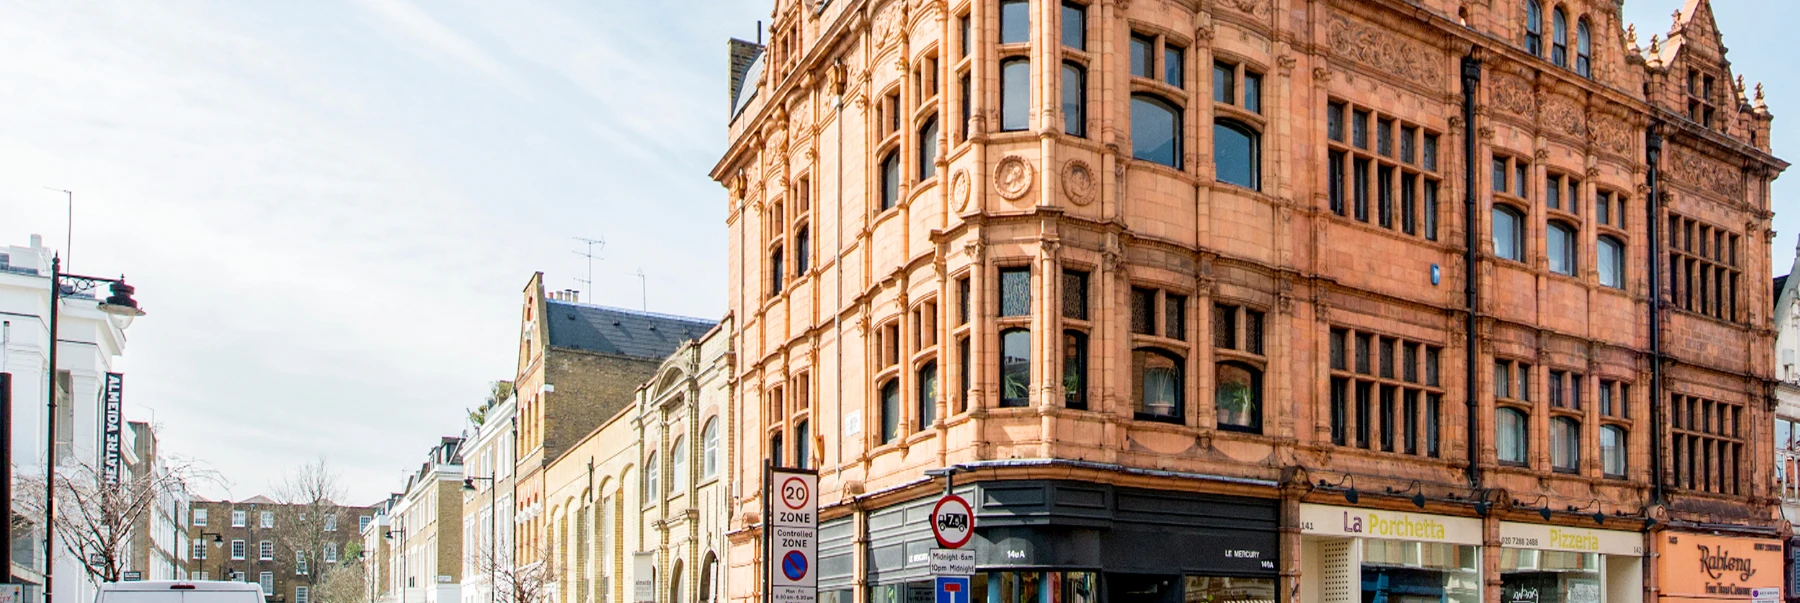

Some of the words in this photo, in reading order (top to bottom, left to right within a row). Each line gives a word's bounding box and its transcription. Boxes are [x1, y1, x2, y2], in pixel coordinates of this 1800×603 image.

[106, 376, 120, 432] ALMEIDA
[105, 433, 118, 490] HEATRE
[786, 486, 805, 501] 20
[780, 512, 811, 524] ZONE
[1301, 521, 1314, 530] 141
[1343, 511, 1363, 533] La
[1368, 513, 1445, 540] Porchetta
[777, 529, 813, 539] Controlled
[1550, 528, 1599, 551] Pizzeria
[782, 538, 808, 548] ZONE
[1224, 549, 1232, 558] LE
[1234, 550, 1260, 559] MERCURY
[931, 564, 947, 572] 10pm
[949, 564, 974, 573] Midnight
